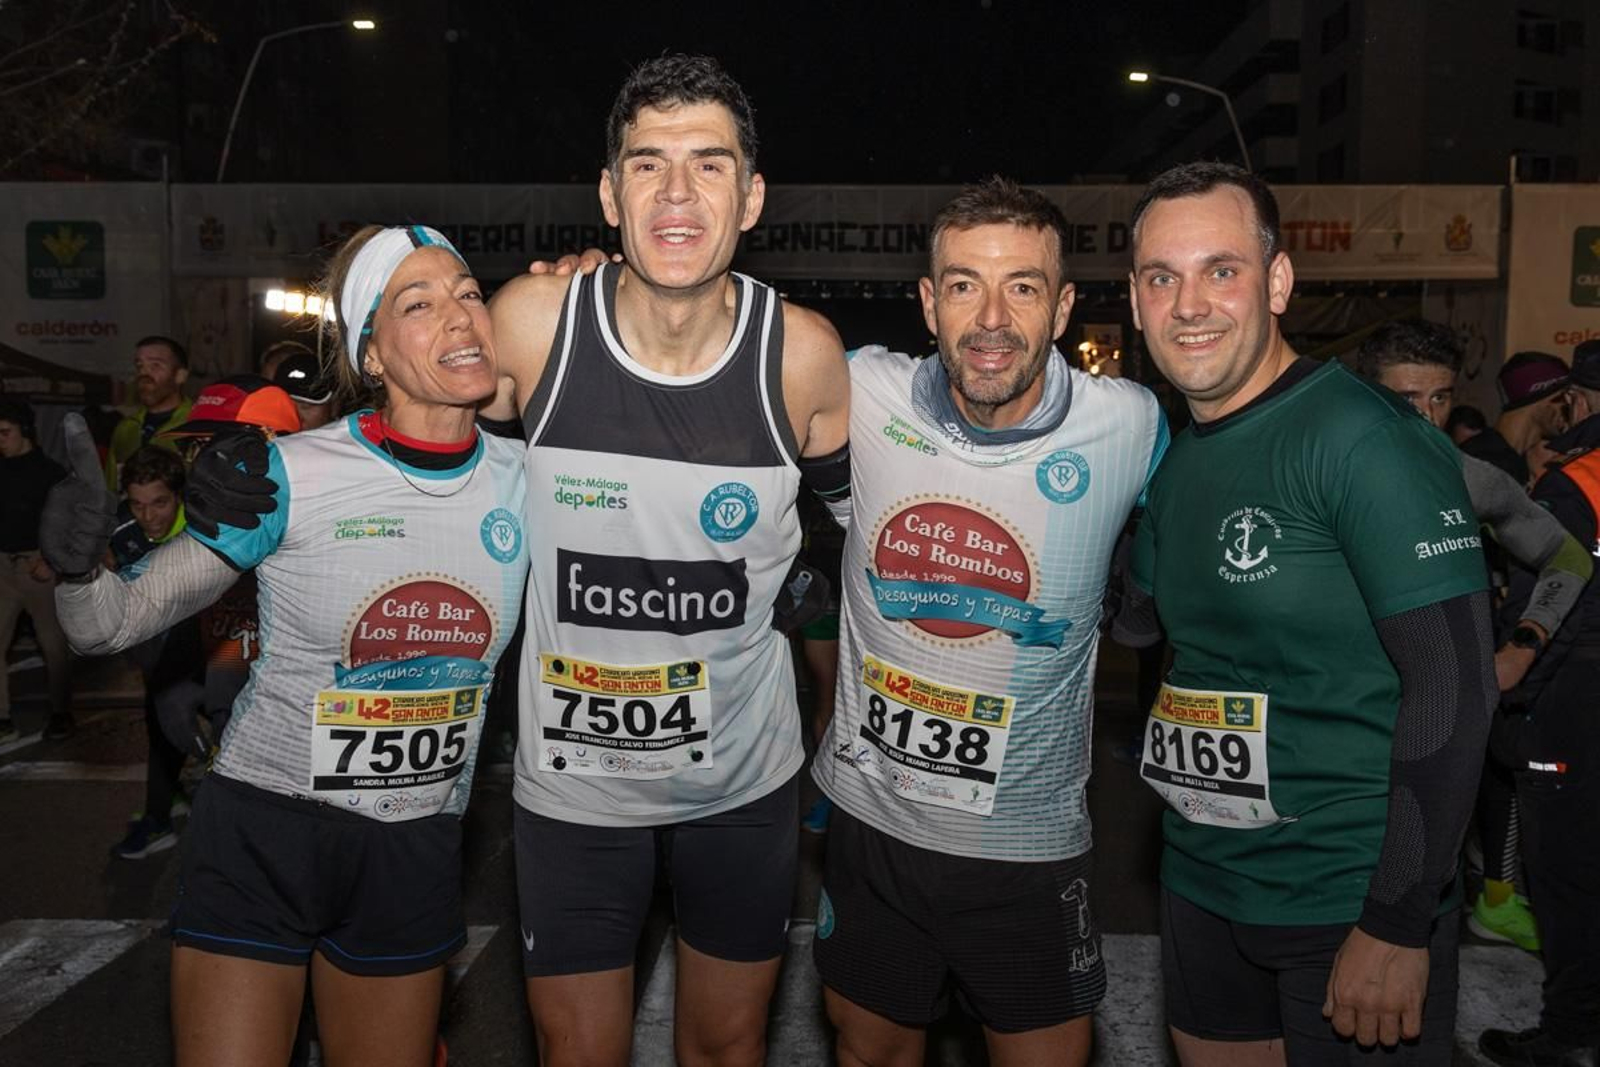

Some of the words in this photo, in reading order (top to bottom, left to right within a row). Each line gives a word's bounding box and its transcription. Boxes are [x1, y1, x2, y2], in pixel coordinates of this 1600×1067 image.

[1283, 221, 1351, 252] TON
[884, 424, 938, 456] deportes
[554, 474, 628, 490] Vélez-Málaga
[554, 487, 628, 510] deportes
[334, 525, 406, 540] deportes
[904, 513, 956, 543] Café
[965, 530, 1009, 556] Bar
[883, 528, 920, 556] Los
[929, 543, 1024, 584] Rombos
[880, 570, 917, 581] desde
[923, 572, 956, 583] 1.990
[568, 562, 735, 622] fascino
[382, 599, 430, 620] Café
[438, 602, 475, 621] Bar
[876, 585, 959, 612] Desayunos
[965, 597, 977, 617] y
[984, 597, 1032, 626] Tapas
[359, 622, 397, 640] Los
[405, 624, 487, 644] Rombos
[341, 665, 425, 689] Desayunos
[431, 667, 440, 687] y
[446, 663, 478, 684] Tapas
[573, 664, 599, 687] 42
[884, 671, 911, 698] 42
[357, 697, 391, 720] 42
[909, 691, 929, 705] SAN
[552, 688, 696, 737] 7504
[868, 693, 990, 766] 8138
[329, 722, 468, 774] 7505
[1151, 721, 1251, 780] 8169
[353, 777, 386, 787] SANDRA
